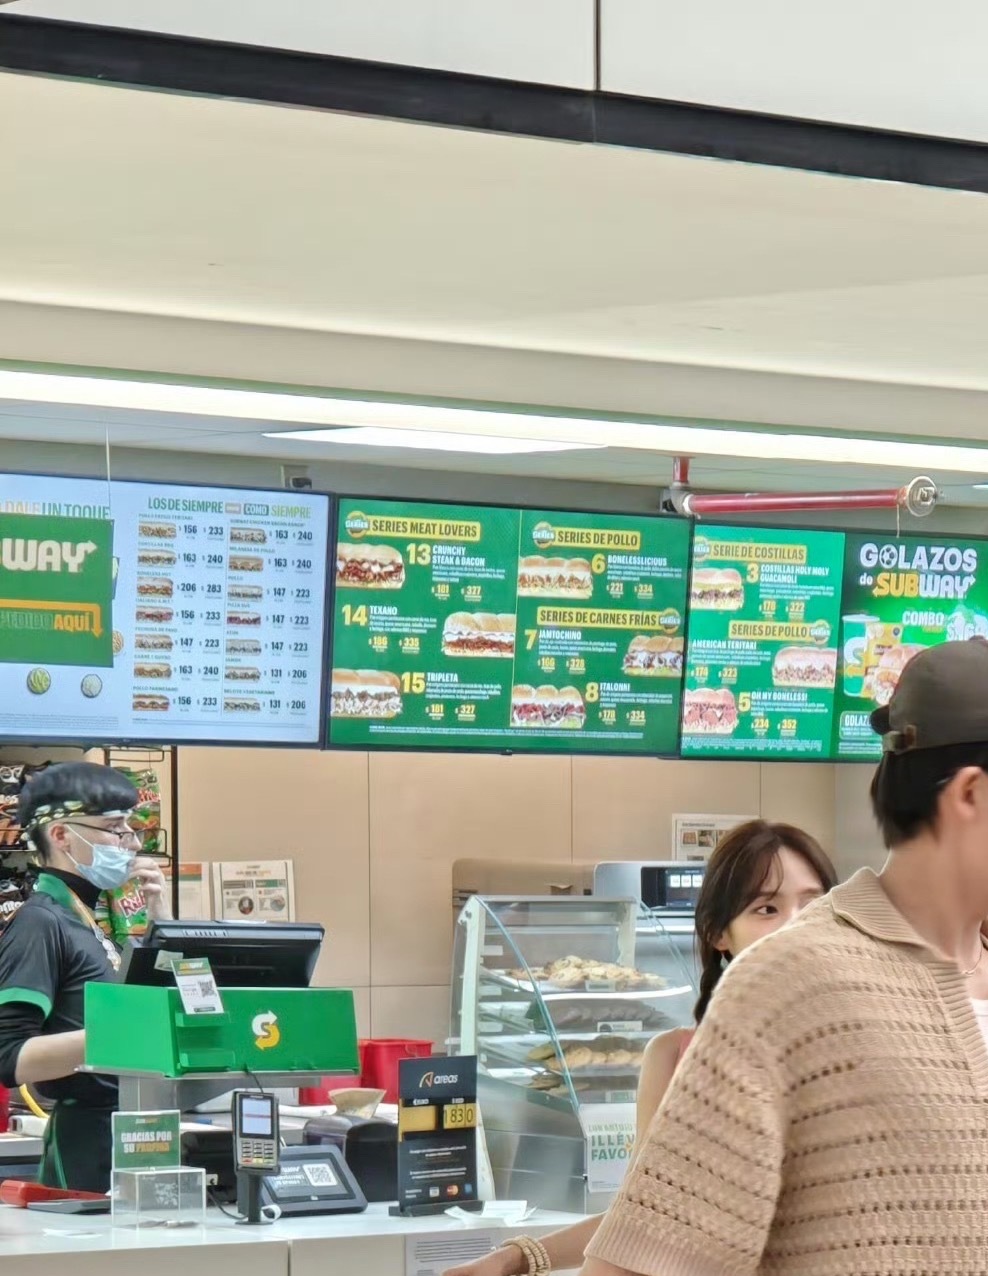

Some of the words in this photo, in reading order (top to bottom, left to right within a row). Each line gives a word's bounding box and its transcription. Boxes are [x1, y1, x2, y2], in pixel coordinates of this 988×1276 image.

[148, 497, 167, 510] LOS
[168, 498, 180, 511] DE
[182, 499, 223, 514] SIEMPRE
[271, 504, 311, 519] SIEMPRE
[372, 520, 408, 534] SERIES
[410, 522, 438, 535] MEAT
[439, 523, 478, 538] LOVERS
[557, 531, 592, 543] SERIES
[593, 532, 606, 544] DE
[607, 533, 638, 546] POLLO
[0, 538, 98, 573] WAY
[406, 543, 431, 565] 13
[713, 544, 740, 558] SERIE
[741, 545, 753, 558] DE
[754, 546, 805, 561] COSTILLAS
[859, 542, 977, 572] GOLAZOS
[591, 553, 606, 574] 6
[746, 562, 759, 583] 3
[761, 563, 795, 575] COSTILLAS
[872, 571, 976, 599] SUBWAY
[341, 604, 368, 626] 14
[369, 605, 398, 616] TEXANO
[540, 610, 574, 623] SERIES
[575, 611, 588, 623] DE
[589, 612, 628, 625] CARNES
[629, 611, 657, 626] FRÍAS
[902, 610, 945, 626] COMBO
[524, 629, 538, 650] 7
[731, 624, 764, 636] SERIES
[765, 625, 778, 637] DE
[778, 626, 808, 638] POLLO
[401, 672, 426, 694] 15
[426, 672, 459, 683] TRIPLETA
[585, 682, 599, 702] 8
[738, 692, 751, 712] 5
[844, 714, 871, 727] GOLAZ
[433, 1074, 459, 1085] areas
